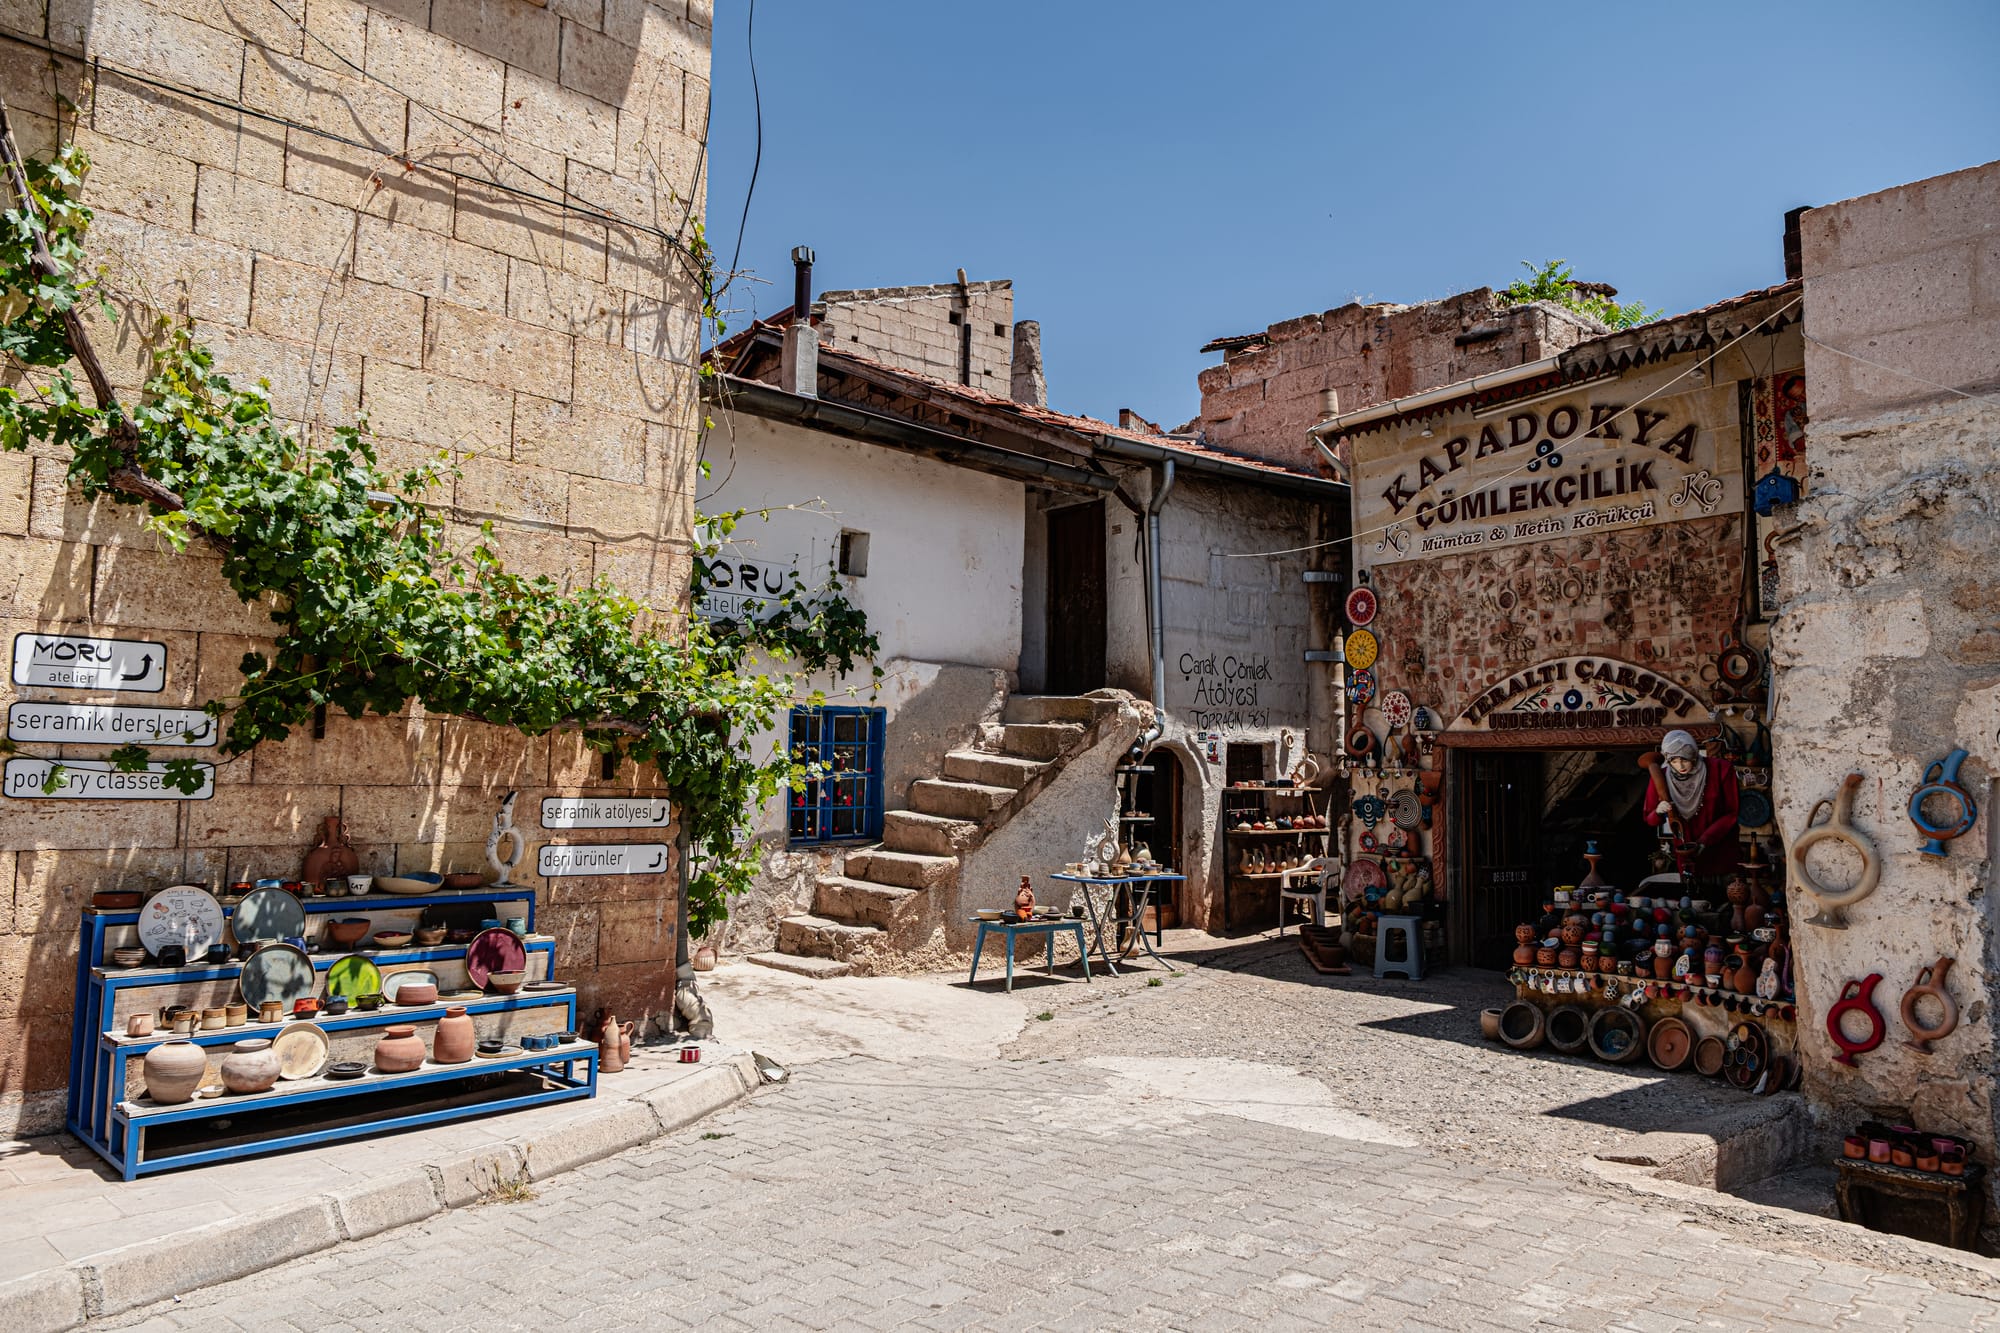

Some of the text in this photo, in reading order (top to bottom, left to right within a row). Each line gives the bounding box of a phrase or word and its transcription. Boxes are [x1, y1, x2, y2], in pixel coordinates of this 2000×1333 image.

[1382, 405, 1696, 515] KAPADOKYA
[1416, 458, 1657, 530] ÇÖMLEKÇİLİK
[1421, 502, 1653, 552] Mümtaz & Metin Körükçü
[705, 559, 783, 595] ORU
[33, 640, 113, 662] MORU
[48, 670, 94, 684] atelier
[1179, 653, 1272, 684] Çanak Çömlek
[1194, 677, 1258, 707] Atölyesi
[1461, 660, 1696, 725] YERALTI ÇARŞISI
[17, 711, 189, 734] seramik dersleri
[1489, 707, 1668, 730] UNDERGROUND SHOP
[13, 769, 172, 794] potry classe
[547, 802, 652, 822] seramik atölyesi
[544, 850, 623, 867] deri ürünler
